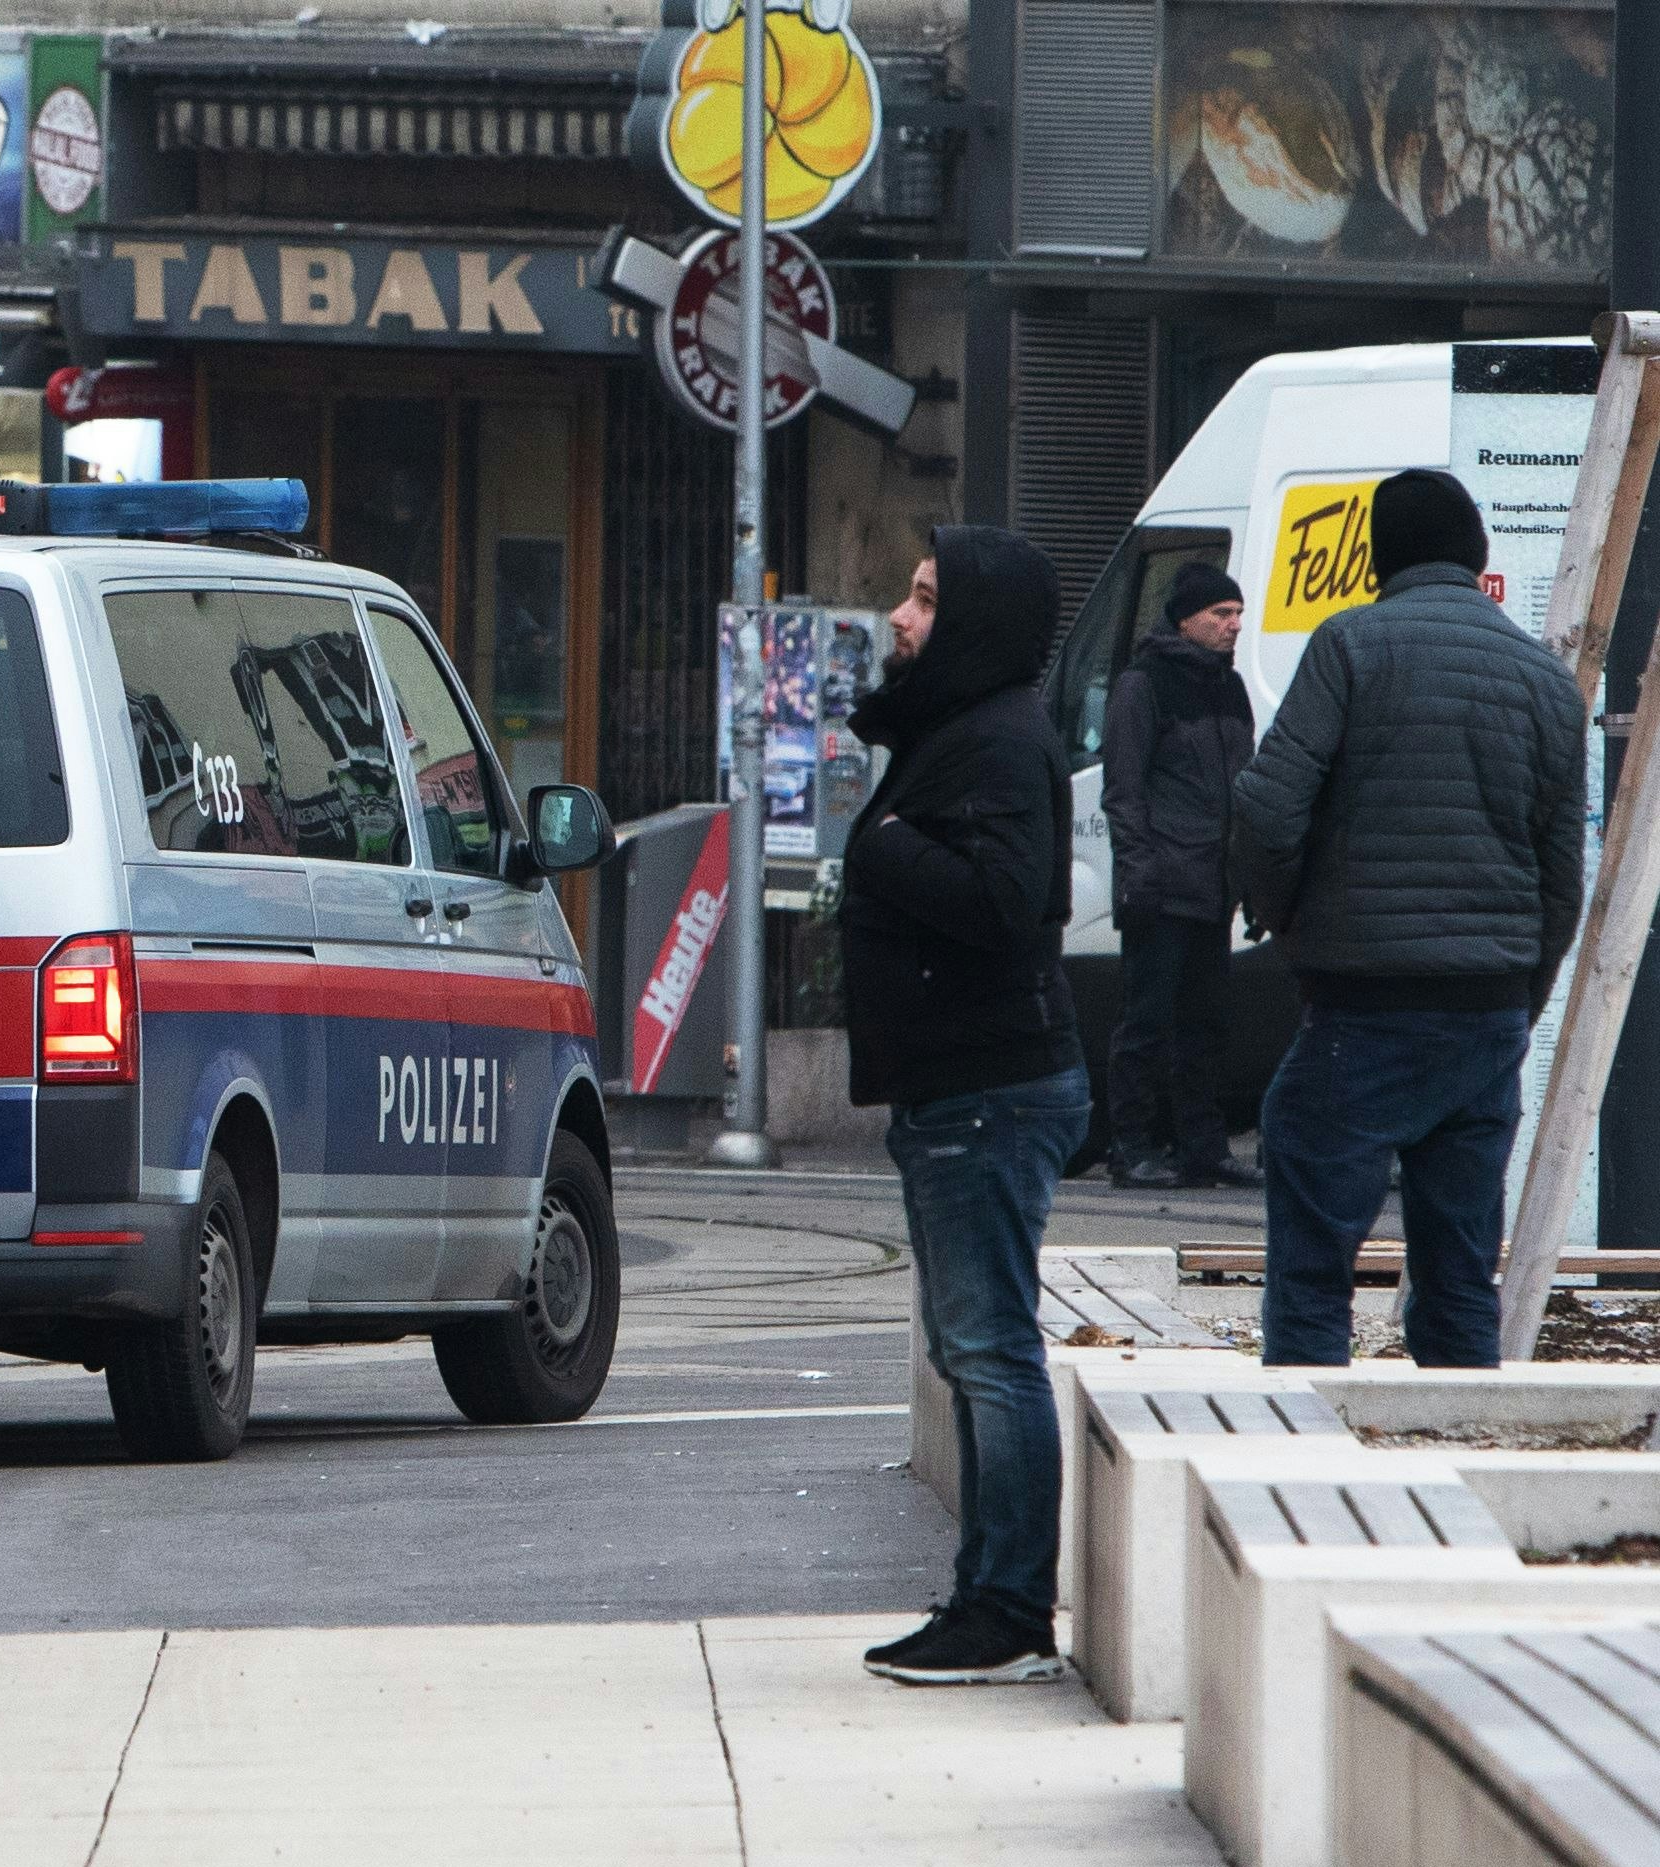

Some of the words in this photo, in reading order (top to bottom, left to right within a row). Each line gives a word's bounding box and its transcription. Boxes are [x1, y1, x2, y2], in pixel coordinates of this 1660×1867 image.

[112, 241, 544, 334] TABAK
[675, 310, 789, 415] TRAFK
[1479, 448, 1583, 466] Reumann
[1285, 495, 1381, 608] Felbe
[205, 754, 245, 825] 133
[641, 888, 720, 1027] Heute
[378, 1055, 498, 1145] POLIZEI
